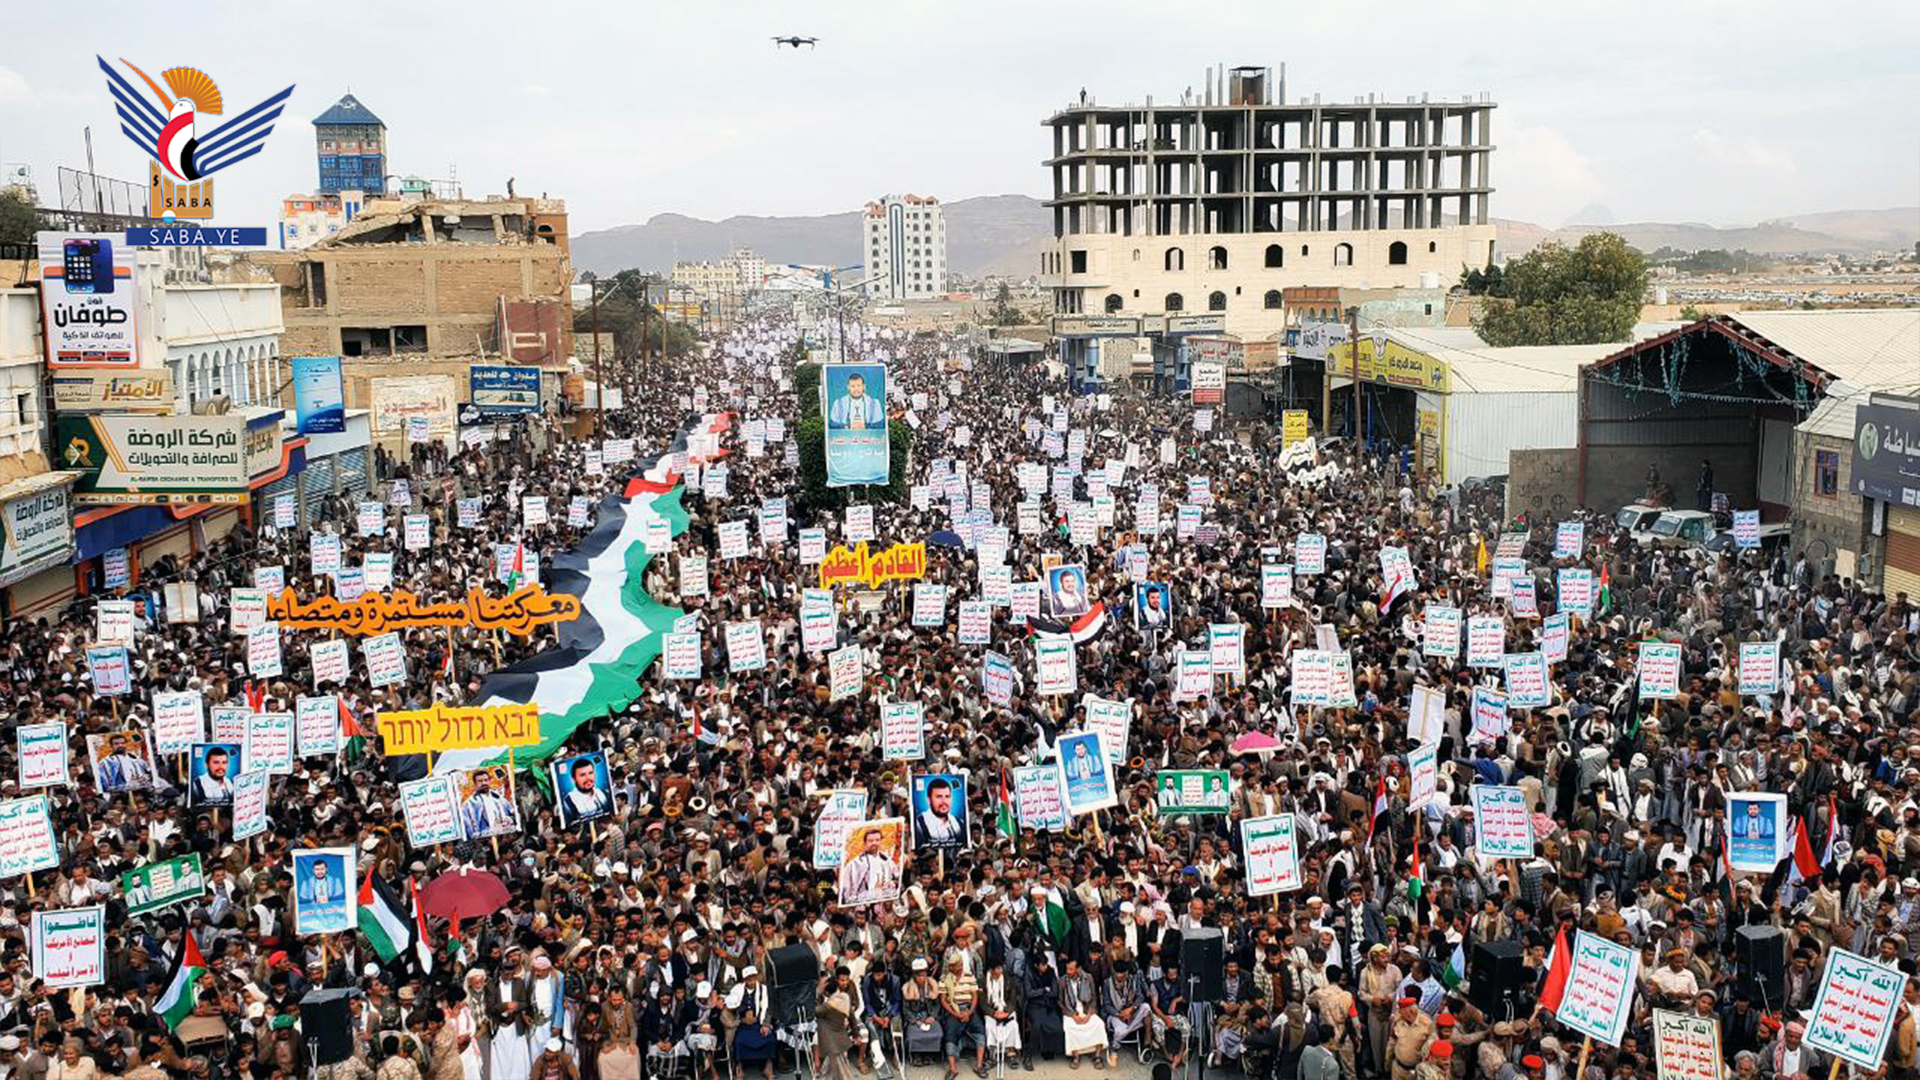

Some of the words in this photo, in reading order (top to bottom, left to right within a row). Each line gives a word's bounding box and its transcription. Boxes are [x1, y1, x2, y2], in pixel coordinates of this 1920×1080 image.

[54, 302, 127, 328] طوفان
[127, 428, 183, 449] الروضة
[188, 428, 237, 449] شركة
[128, 452, 189, 467] والتحويلات
[192, 452, 238, 466] للصرافة
[16, 496, 42, 521] الروضة
[42, 489, 64, 513] شركة
[821, 543, 865, 586] أعظم
[871, 549, 922, 585] القادم
[370, 599, 464, 630] مستمرة
[474, 590, 575, 629] معركتنا
[383, 719, 431, 745] יותר
[436, 709, 486, 743] גדול
[494, 710, 538, 739] הבא
[44, 915, 97, 935] قاطعوا
[1579, 946, 1608, 961] أكبر
[1608, 953, 1631, 973] الله
[1835, 964, 1874, 983] أكبر
[1870, 973, 1898, 995] الله
[1662, 1019, 1690, 1033] أكبر
[1693, 1022, 1711, 1035] الله
